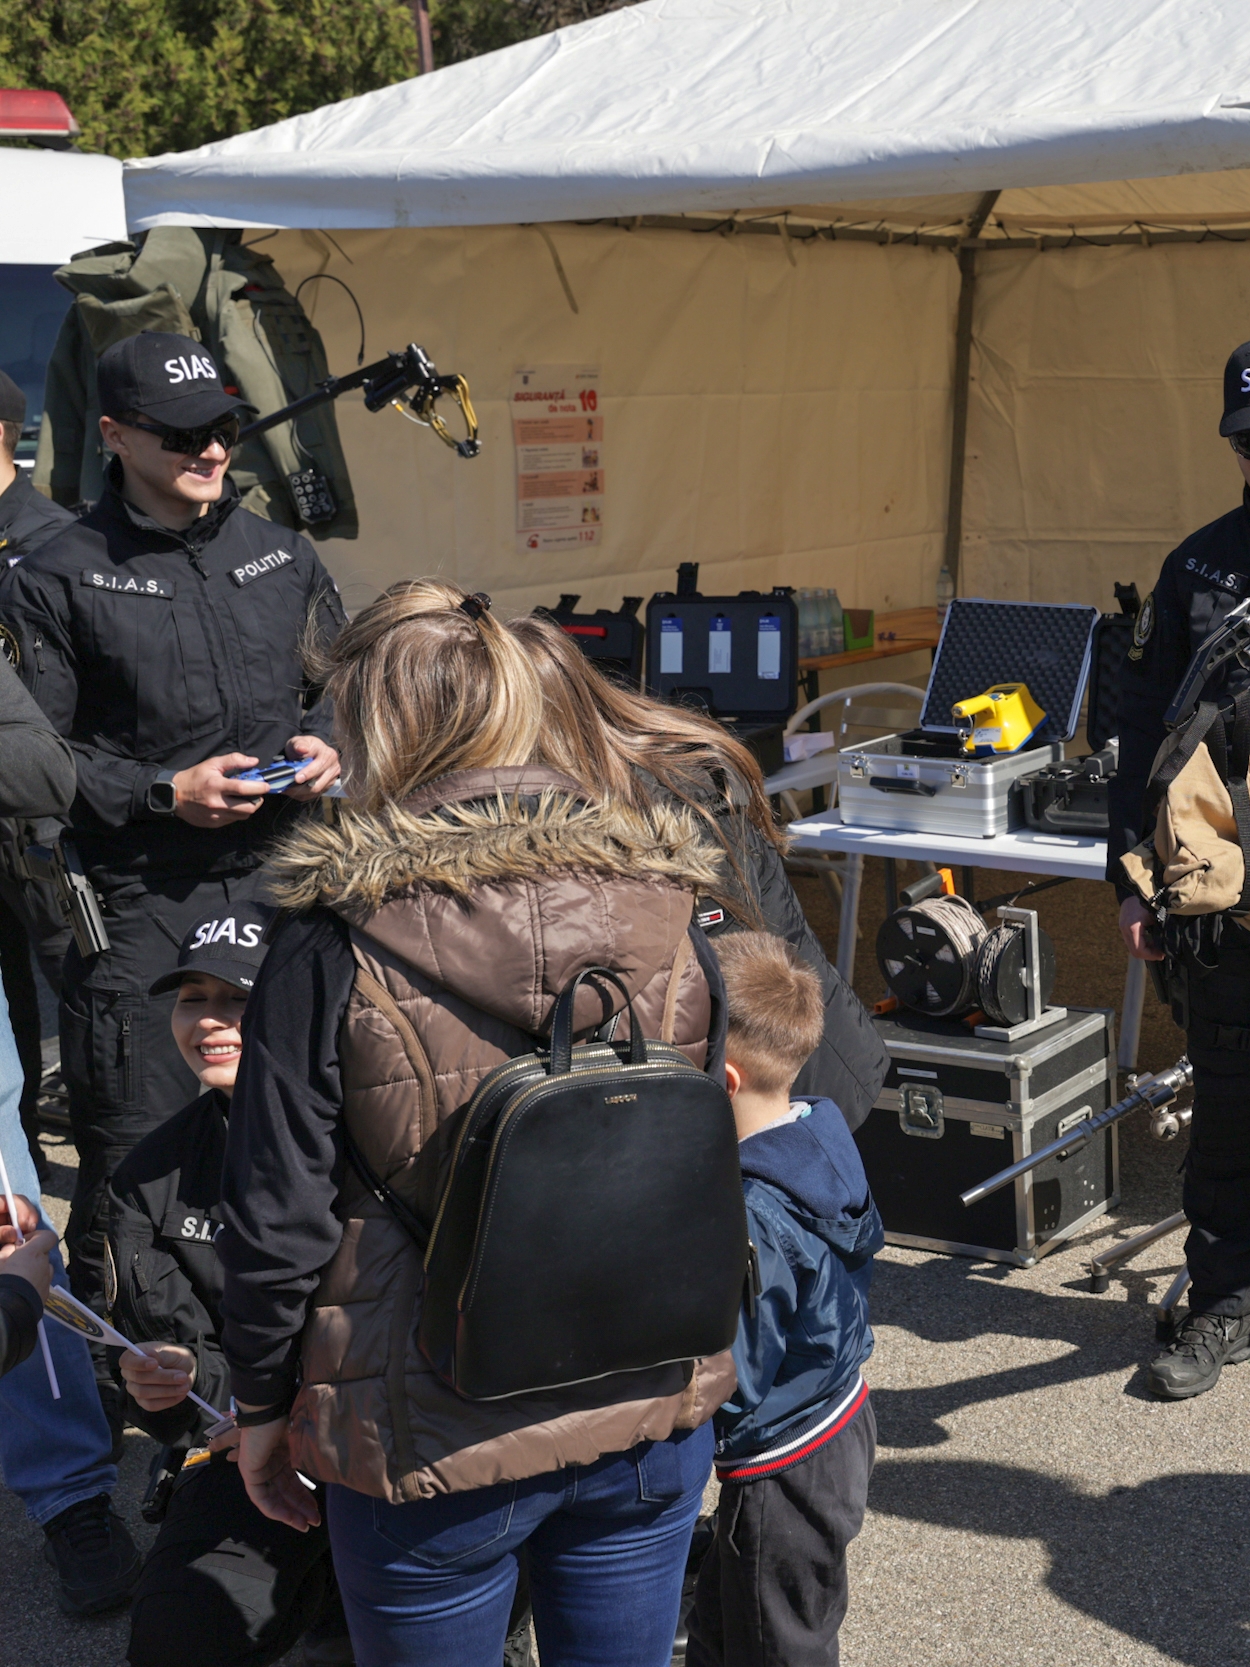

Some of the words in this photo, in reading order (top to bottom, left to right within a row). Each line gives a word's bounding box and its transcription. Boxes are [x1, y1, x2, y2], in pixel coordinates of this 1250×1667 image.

[164, 354, 217, 384] SIAS
[579, 389, 597, 412] 10
[579, 530, 595, 542] 112
[234, 549, 292, 583] POLITIA
[1185, 558, 1238, 590] S.I.A.S.
[92, 573, 165, 594] S.I.A.S.
[189, 917, 263, 950] SIAS
